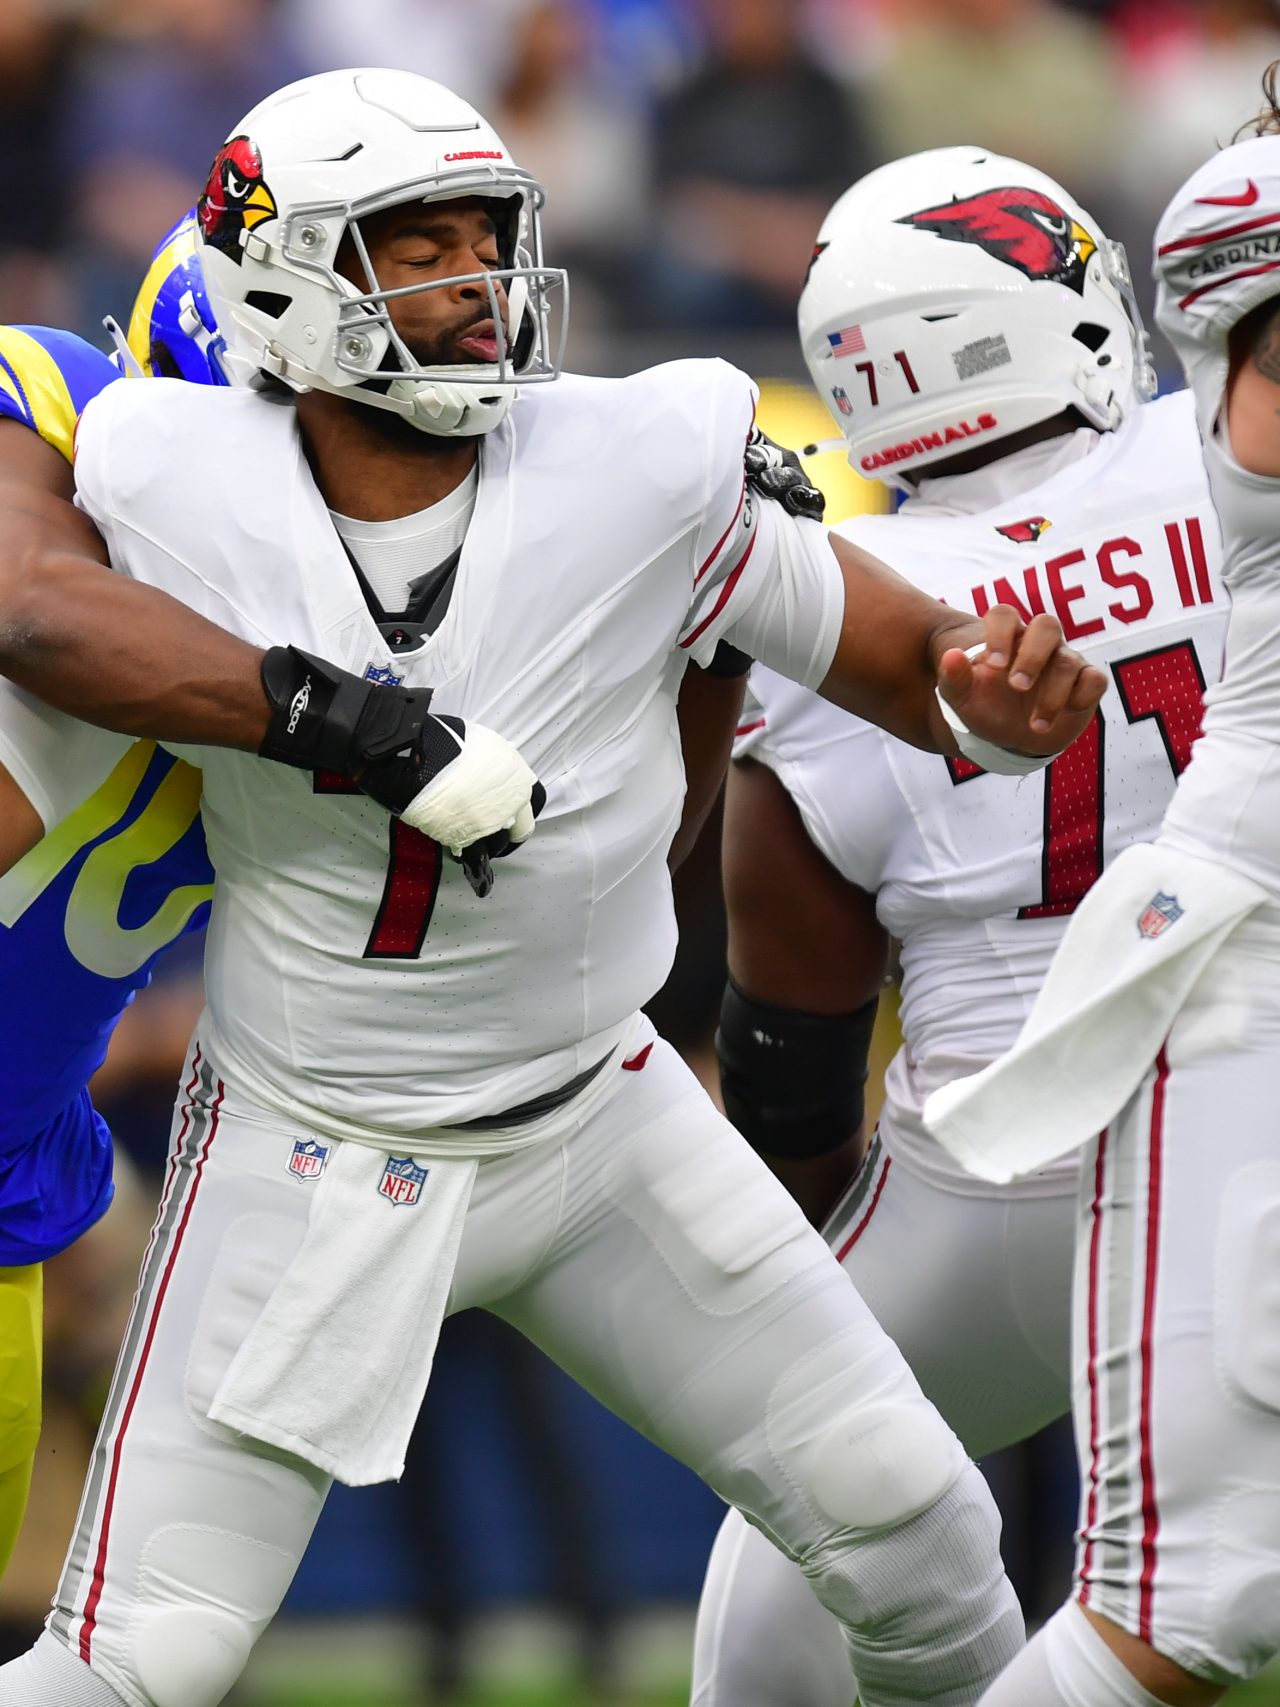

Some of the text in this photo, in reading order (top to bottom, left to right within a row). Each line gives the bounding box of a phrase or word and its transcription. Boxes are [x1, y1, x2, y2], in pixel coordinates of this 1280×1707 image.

[855, 349, 921, 407] 71
[860, 412, 998, 472] CARDINALS
[1163, 517, 1215, 609] II
[292, 1154, 318, 1174] NFL
[382, 1174, 416, 1202] NFL
